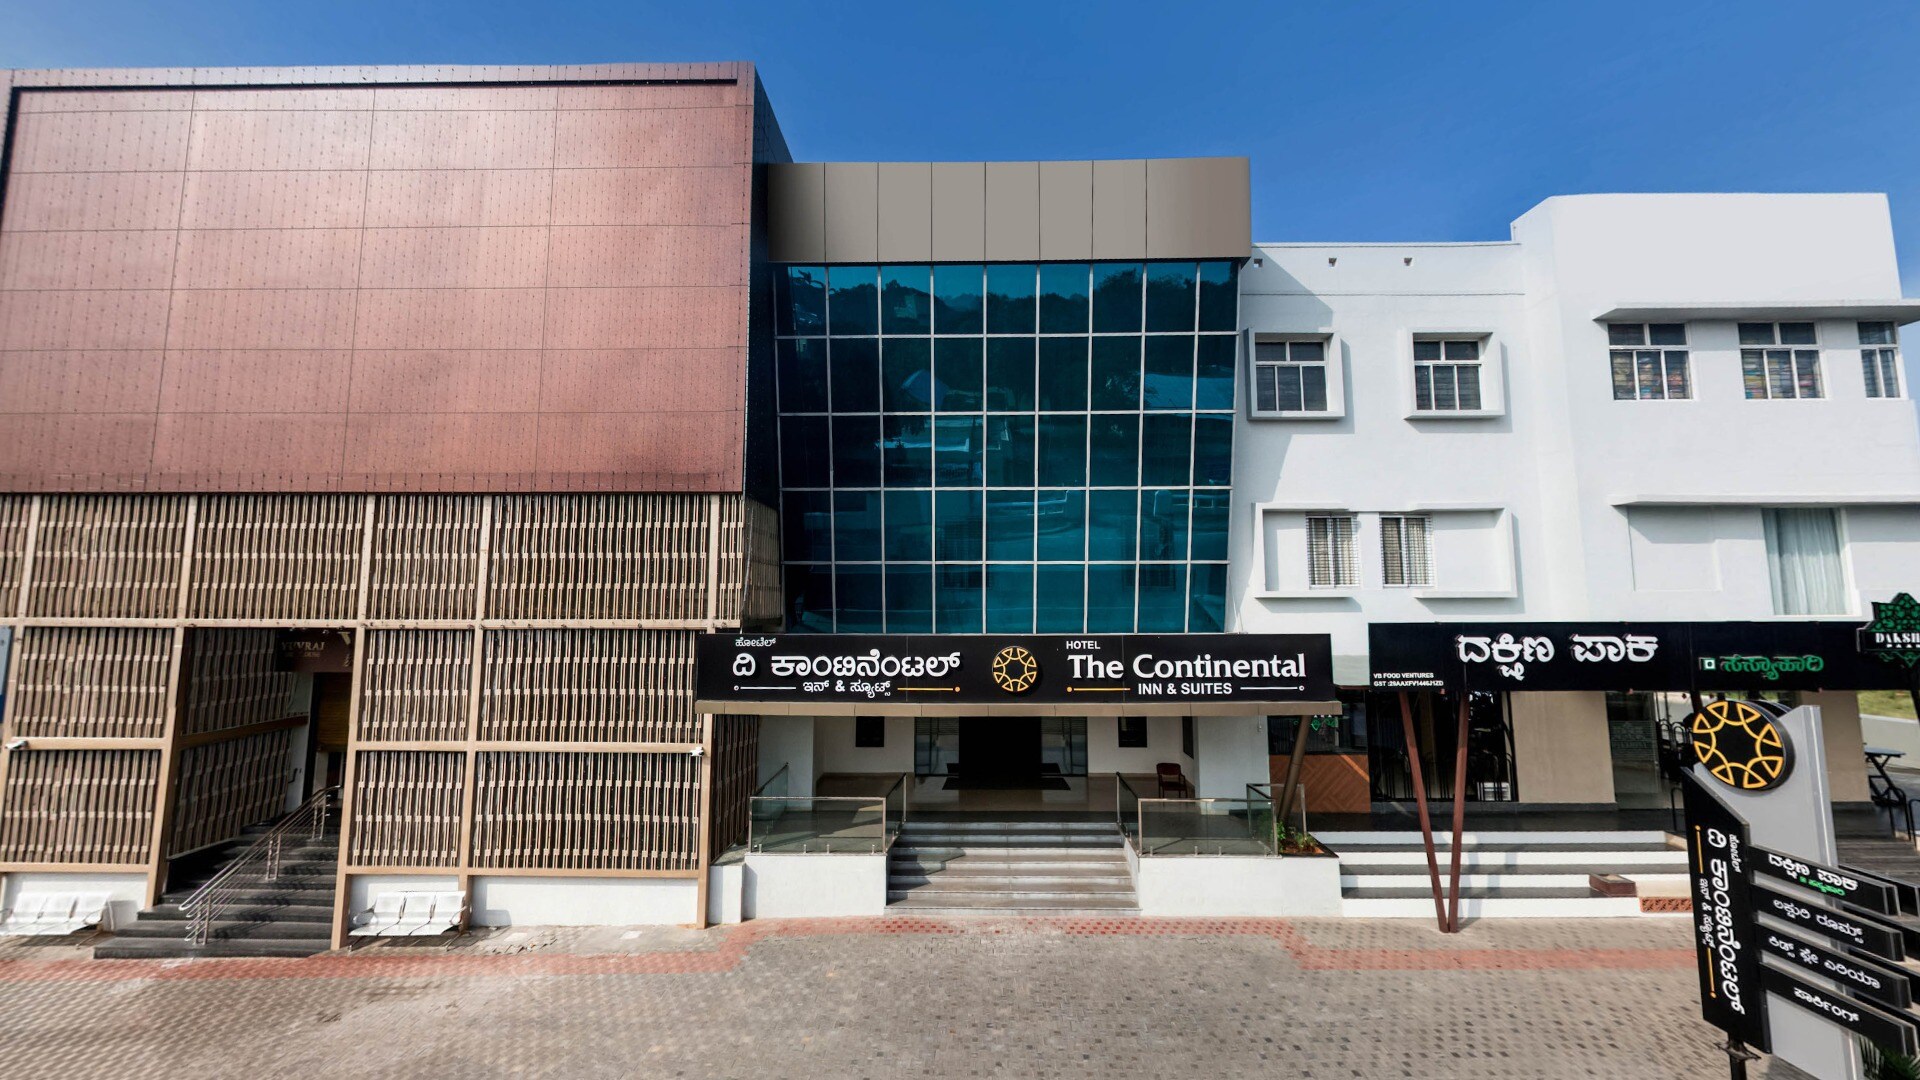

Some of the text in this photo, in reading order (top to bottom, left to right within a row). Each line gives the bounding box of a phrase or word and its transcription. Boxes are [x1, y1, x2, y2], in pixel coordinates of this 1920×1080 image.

[735, 637, 777, 648] ಹೋಟೆಲ್
[1065, 640, 1101, 650] HOTEL
[732, 648, 961, 678] ದಿ ಕಾಂಟಿನೆಂಟಲ್
[1067, 653, 1307, 679] The Continental
[1456, 633, 1659, 681] ದಕ್ಷಿಣ ಪಾಕ
[802, 680, 830, 693] ಇನ್
[834, 679, 846, 693] &
[1138, 682, 1233, 695] INN & SUITES
[1817, 866, 1858, 891] ಪಾಕ
[1702, 903, 1713, 911] &
[1708, 828, 1746, 1015] ದಿ ಕಾಂಟಿನೆಂಟಲ್
